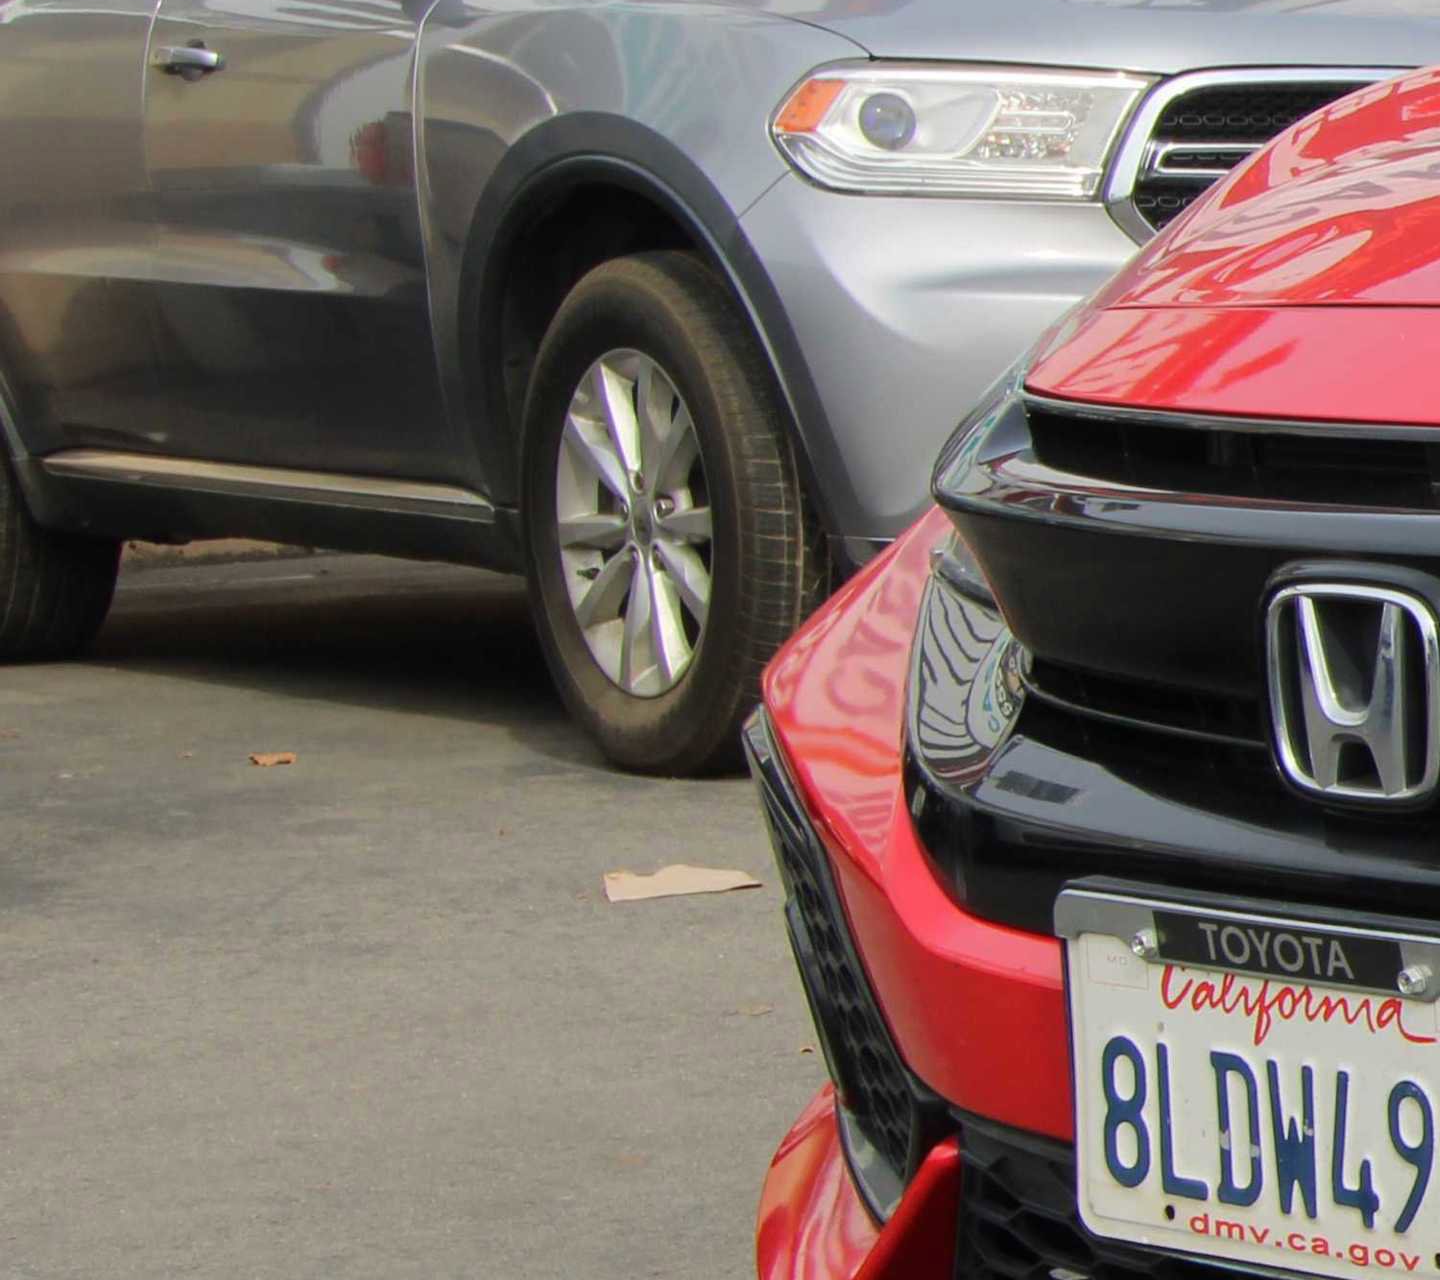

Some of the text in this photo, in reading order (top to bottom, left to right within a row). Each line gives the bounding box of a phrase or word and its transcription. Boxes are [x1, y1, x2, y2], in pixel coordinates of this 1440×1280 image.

[1199, 922, 1354, 979] TOYOTA
[1161, 964, 1436, 1046] California
[1189, 1213, 1422, 1272] dmv.ca.gov
